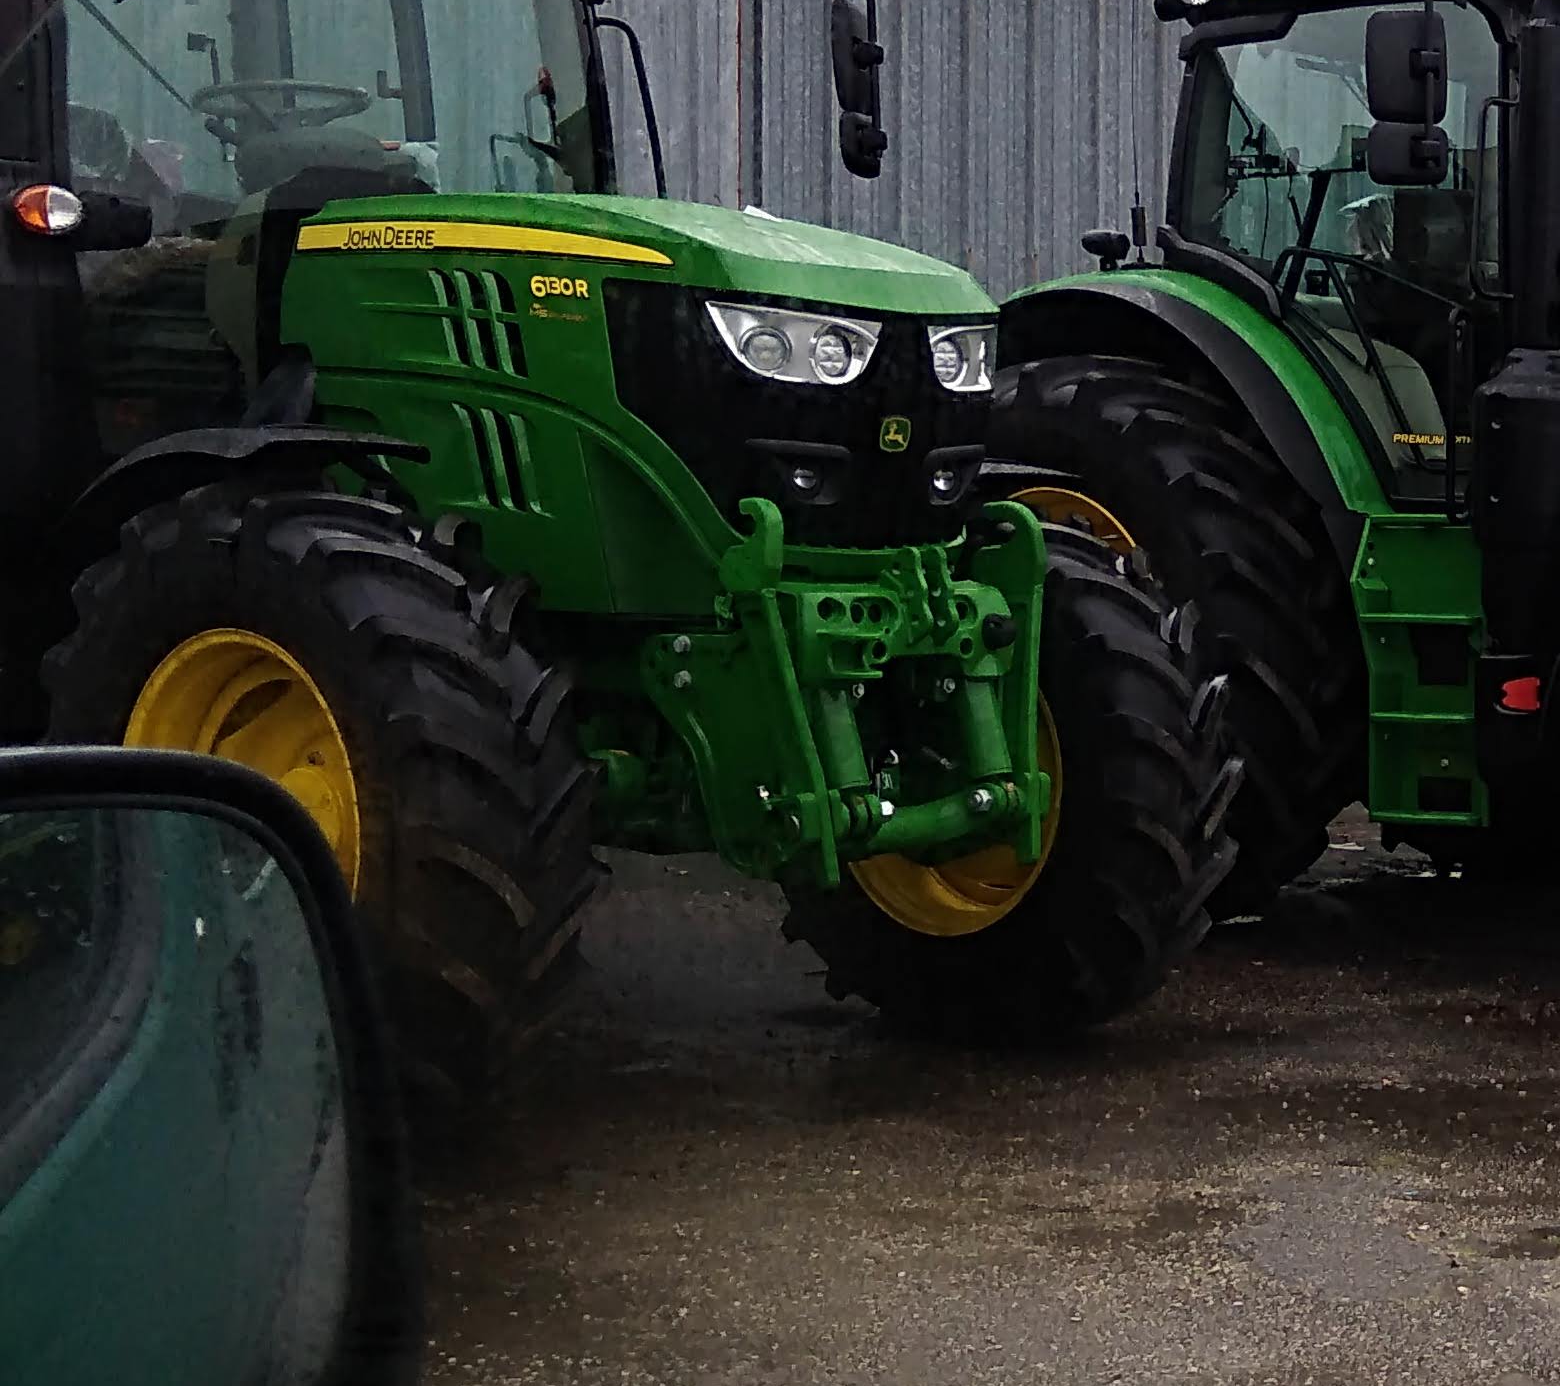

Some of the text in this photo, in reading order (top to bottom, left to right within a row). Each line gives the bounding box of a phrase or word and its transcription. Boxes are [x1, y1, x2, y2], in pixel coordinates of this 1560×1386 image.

[342, 226, 435, 247] JOHN DEERE
[1393, 433, 1445, 445] PREMIUM
